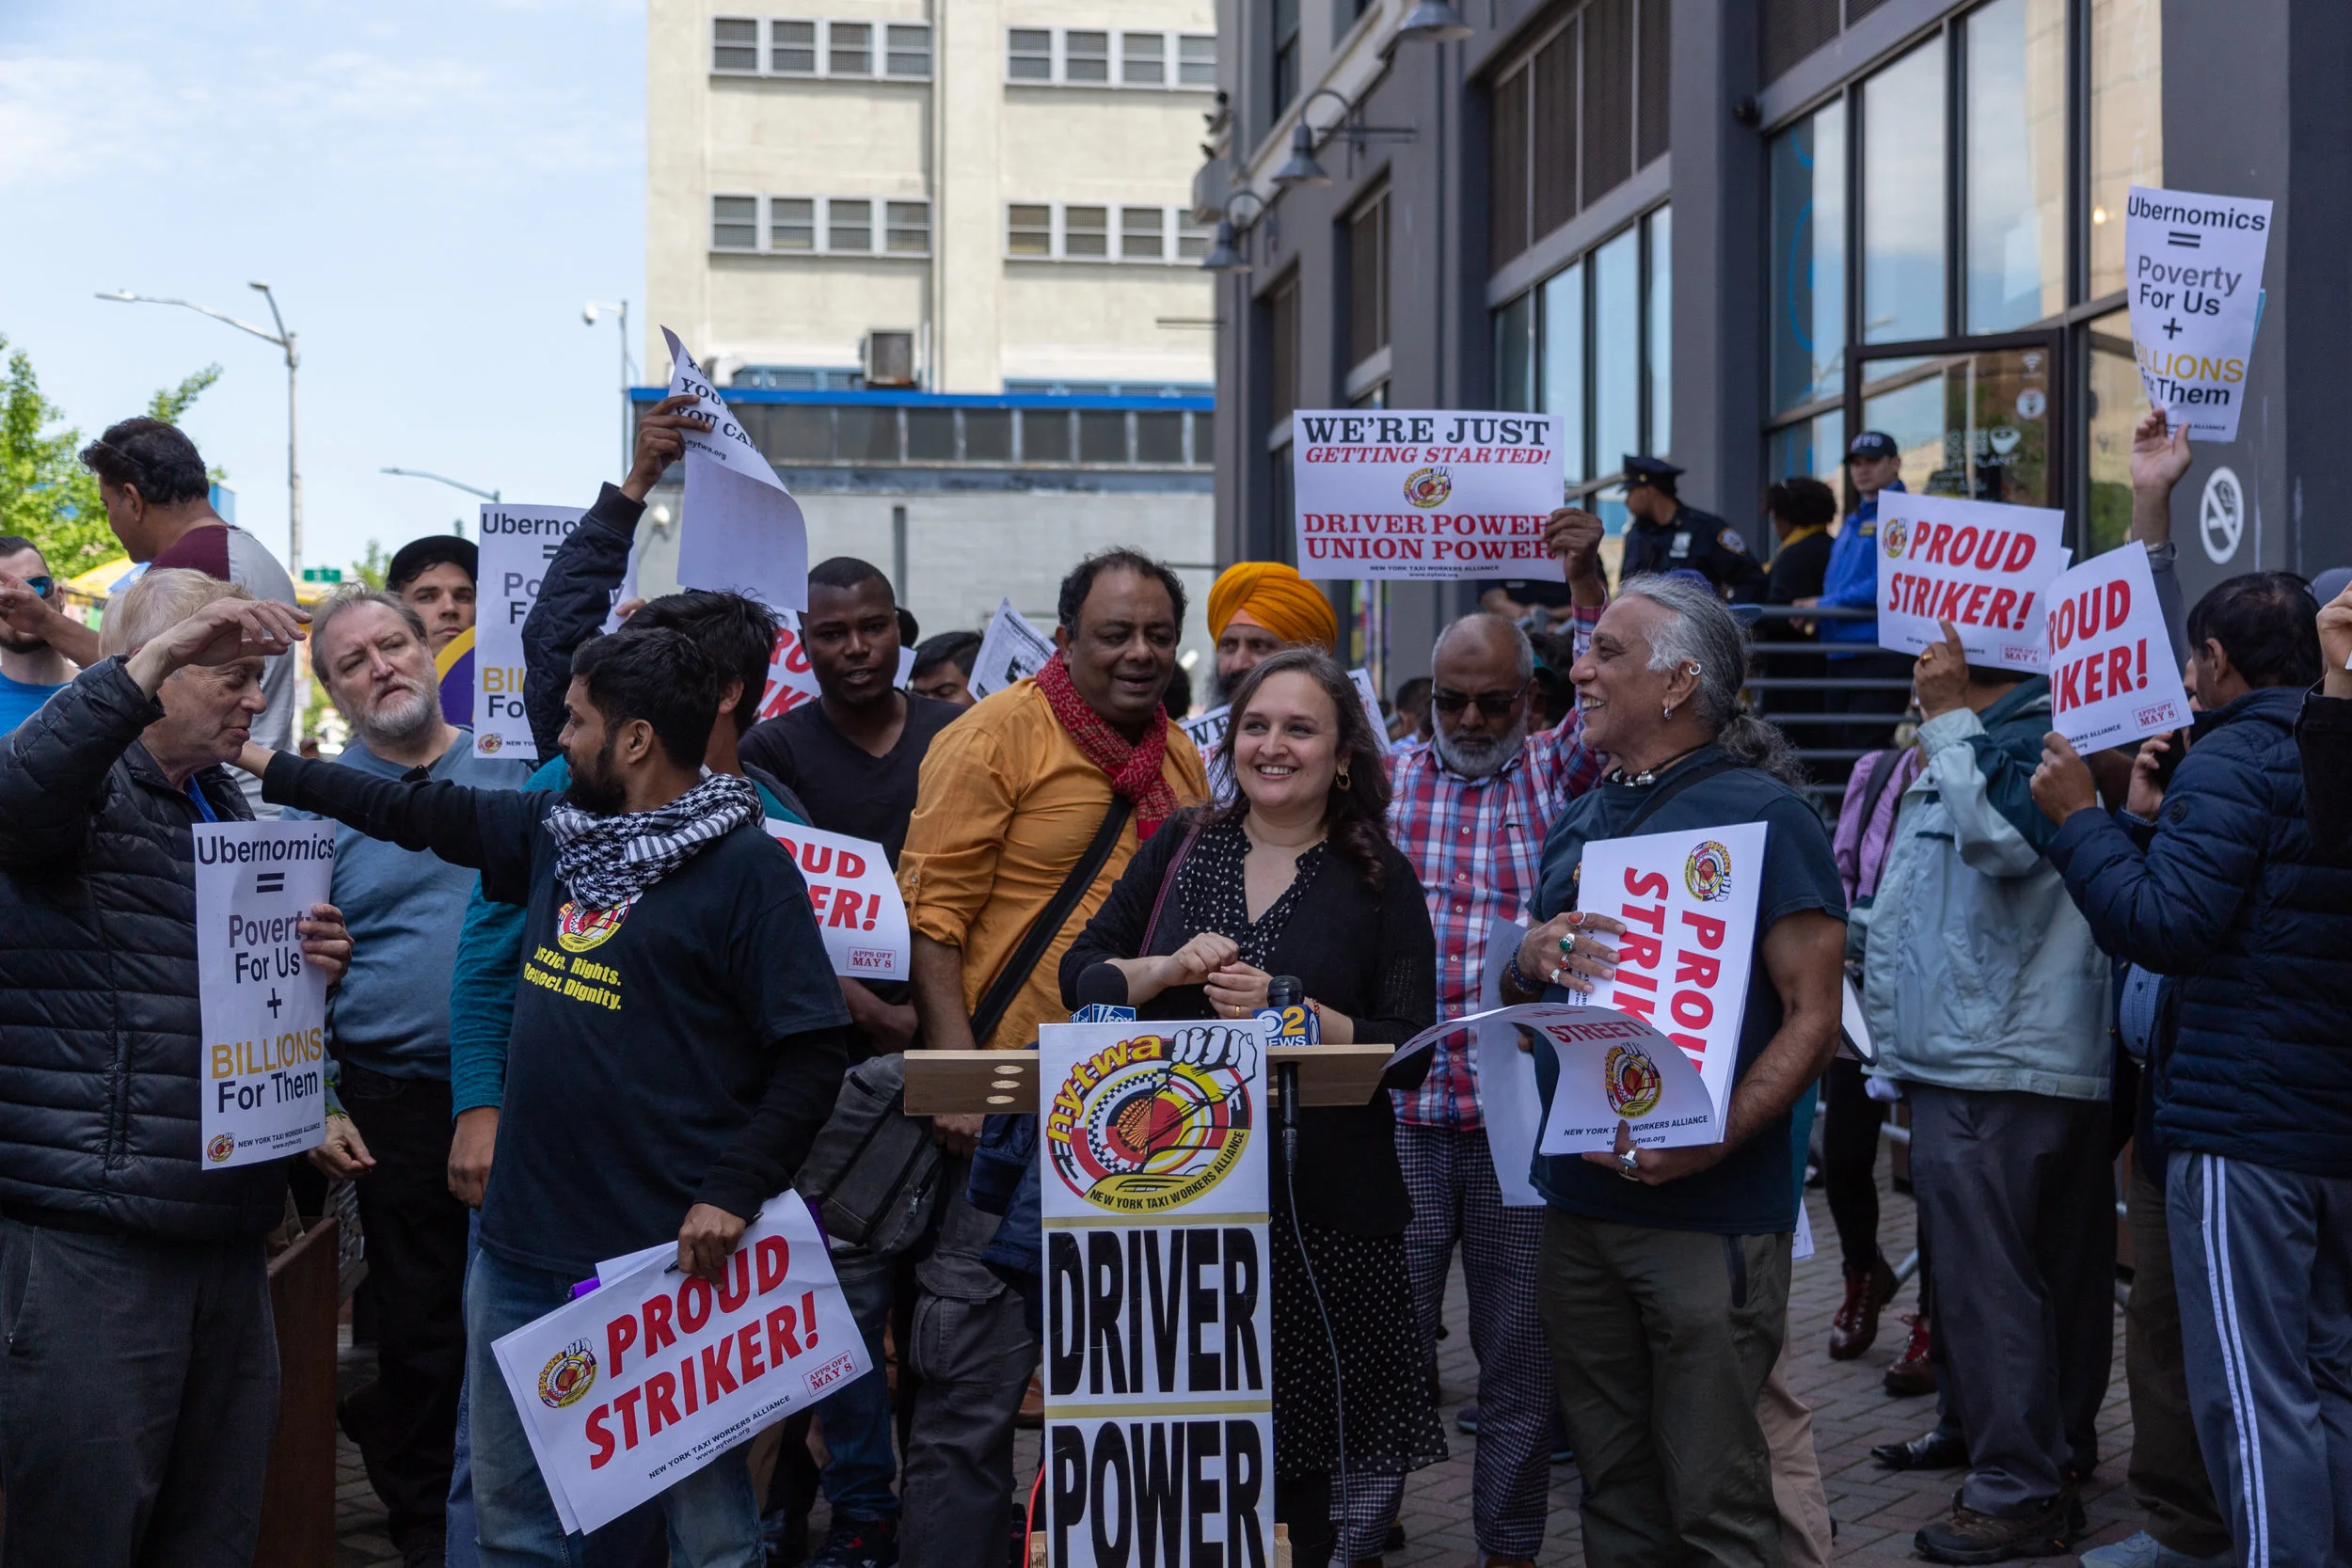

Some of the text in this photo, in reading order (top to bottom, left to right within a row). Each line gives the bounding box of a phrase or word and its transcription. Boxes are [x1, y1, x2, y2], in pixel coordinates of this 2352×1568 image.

[2127, 195, 2265, 231] Ubernomics
[2137, 255, 2242, 297] Poverty
[2139, 283, 2220, 316] For Us
[681, 377, 722, 405] YOU
[2157, 377, 2230, 405] Them
[1302, 417, 1549, 446] WE'RE JUST
[685, 438, 727, 461] .nytwa.org
[1305, 447, 1551, 465] GETTING STARTED!
[482, 513, 578, 536] Uberno
[1303, 514, 1427, 534] DRIVER
[1306, 537, 1557, 561] UNION POWER
[1908, 520, 2037, 573] PROUD
[1888, 572, 2036, 631] STRIKER!
[2046, 579, 2131, 656] ROUD
[2050, 638, 2148, 718] IKER!
[487, 695, 525, 719] Fo
[2139, 709, 2174, 726] MAY 8
[2090, 723, 2122, 738] ALLIANCE
[197, 833, 335, 865] Ubernomics
[229, 911, 310, 948] Povert
[852, 958, 892, 968] MAY 8
[1613, 866, 1669, 1028] STRIK
[235, 946, 300, 984] For Us
[570, 957, 622, 986] Rights.
[563, 978, 622, 1010] Dignity.
[1667, 911, 1725, 1074] PROU
[1281, 1006, 1306, 1037] 2
[1545, 1020, 1651, 1044] STREET!
[212, 1027, 323, 1080] BILLIONS
[1267, 1036, 1307, 1046] EWS
[218, 1070, 318, 1114] For Them
[1045, 1034, 1162, 1145] nytwa
[238, 1122, 321, 1148] NEW YORK TAXI WORKERS ALLIANCE
[1564, 1128, 1583, 1136] NEW
[1585, 1127, 1610, 1135] YORK
[1632, 1121, 1670, 1132] WORKERS
[1671, 1115, 1708, 1128] ALLIANCE
[1089, 1130, 1246, 1210] NEW YORK TAXI WORKERS ALLIANCE
[607, 1235, 789, 1379] PROUD
[1048, 1227, 1263, 1396] DRIVER
[585, 1291, 818, 1470] STRIKER!
[809, 1354, 849, 1381] APPS OFF
[811, 1362, 852, 1390] MAY 8
[648, 1395, 791, 1480] NEW YORK TAXI WORKERS ALLIANCE
[695, 1427, 750, 1461] www.nytwa.org
[1052, 1419, 1266, 1568] POWER
